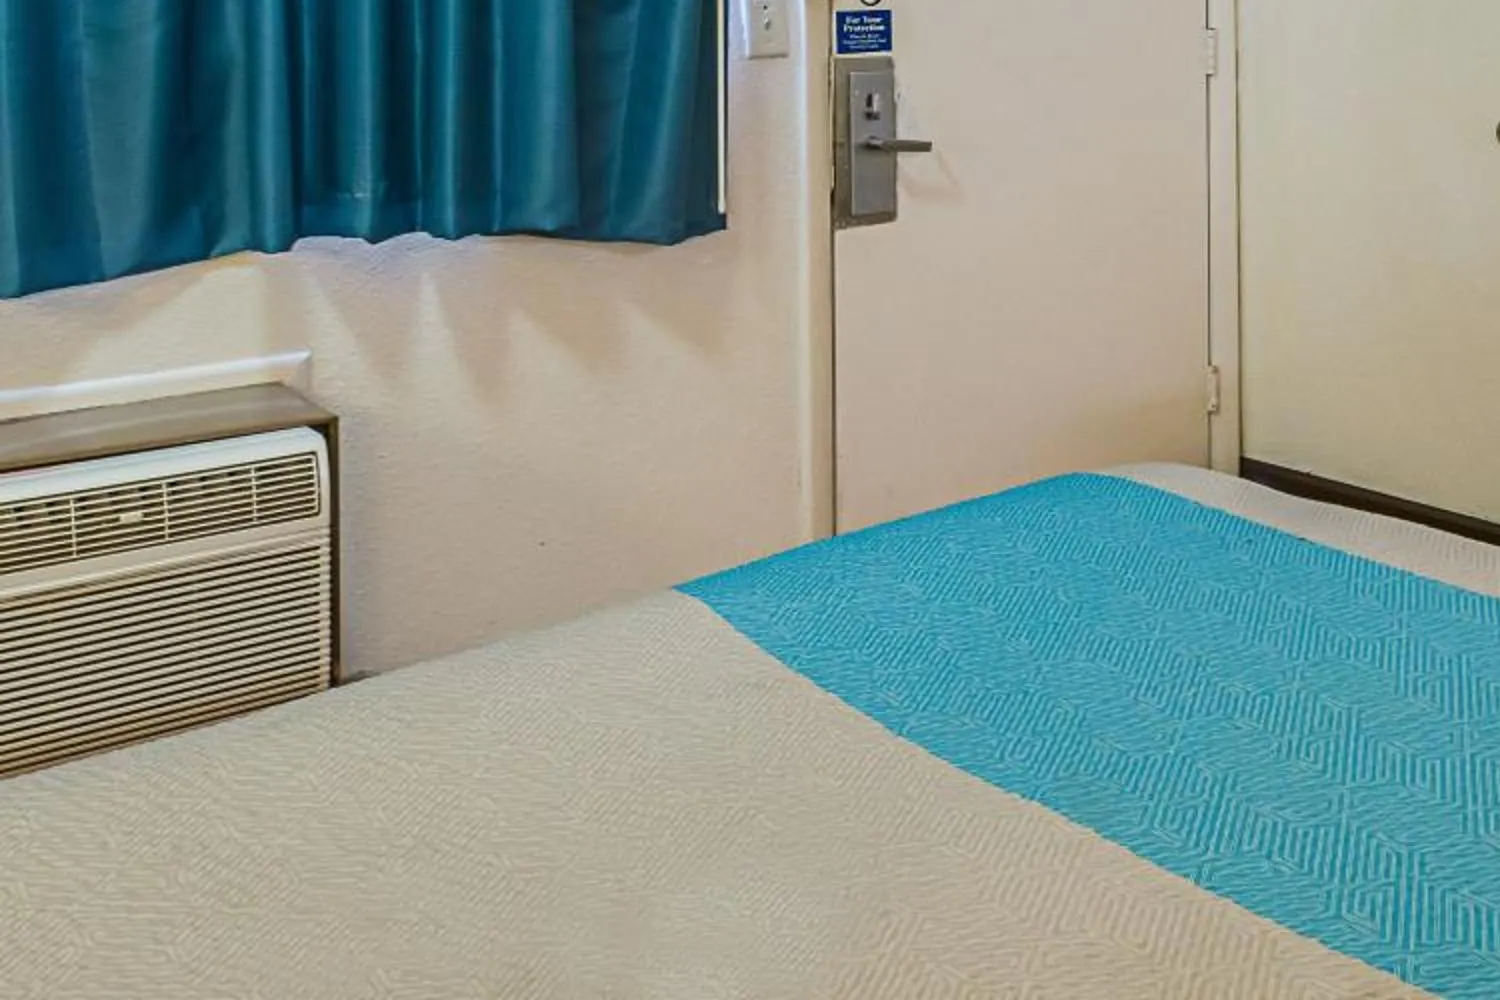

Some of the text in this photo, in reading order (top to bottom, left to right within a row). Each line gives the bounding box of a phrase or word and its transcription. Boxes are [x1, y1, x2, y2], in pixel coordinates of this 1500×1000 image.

[845, 15, 883, 24] For Your
[843, 24, 885, 32] Protection
